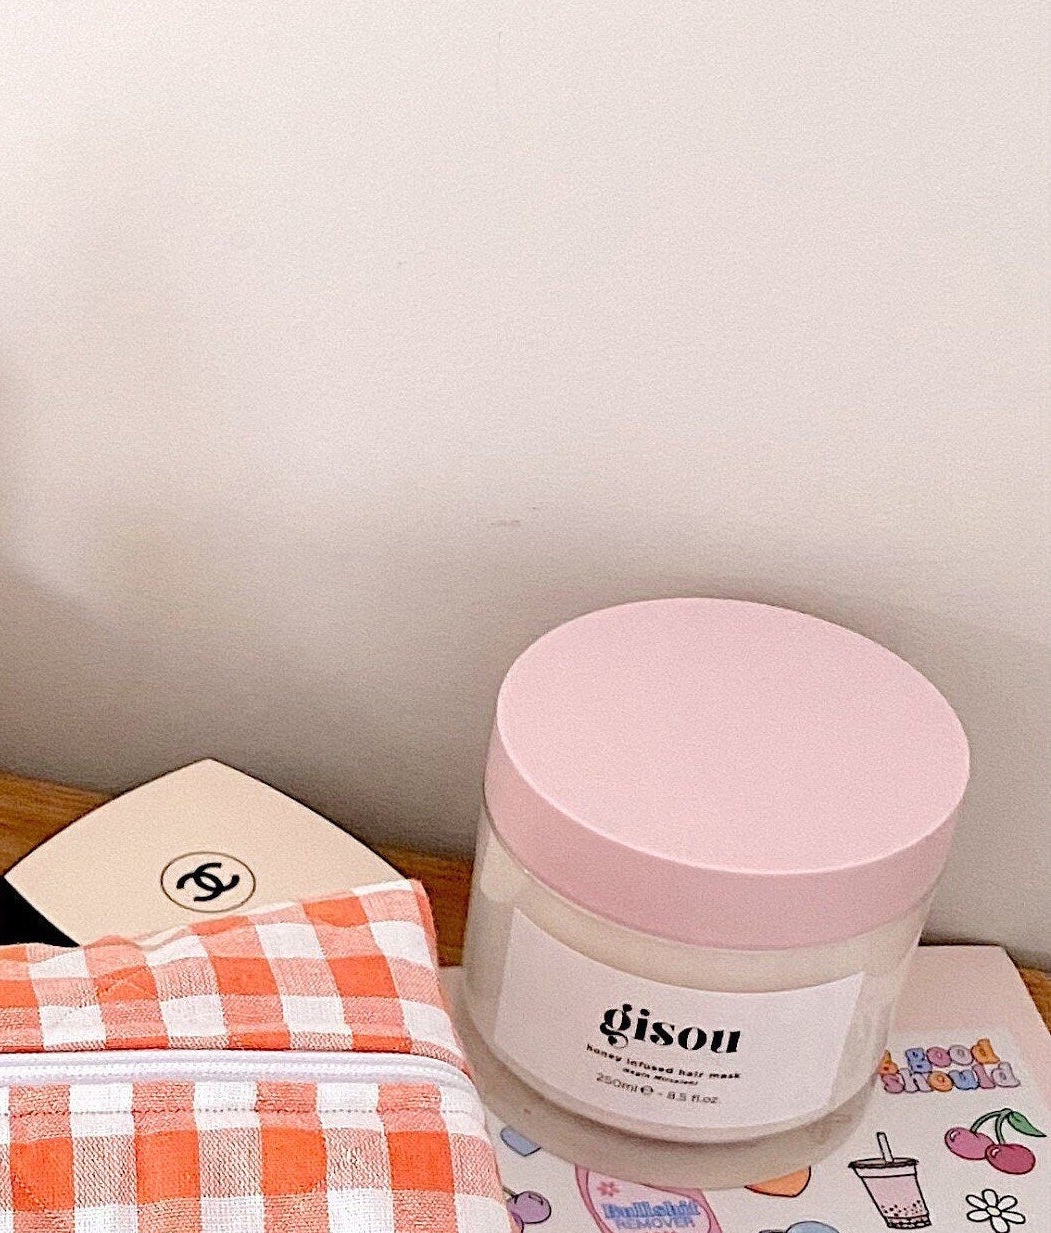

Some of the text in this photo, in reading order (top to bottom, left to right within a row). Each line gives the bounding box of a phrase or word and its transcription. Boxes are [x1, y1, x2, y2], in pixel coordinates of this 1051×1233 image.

[599, 1003, 741, 1053] gisou
[586, 1043, 623, 1063] honey
[626, 1058, 674, 1074] infused
[678, 1069, 705, 1078] hair
[708, 1071, 742, 1080] mask
[595, 1071, 638, 1093] 250ml
